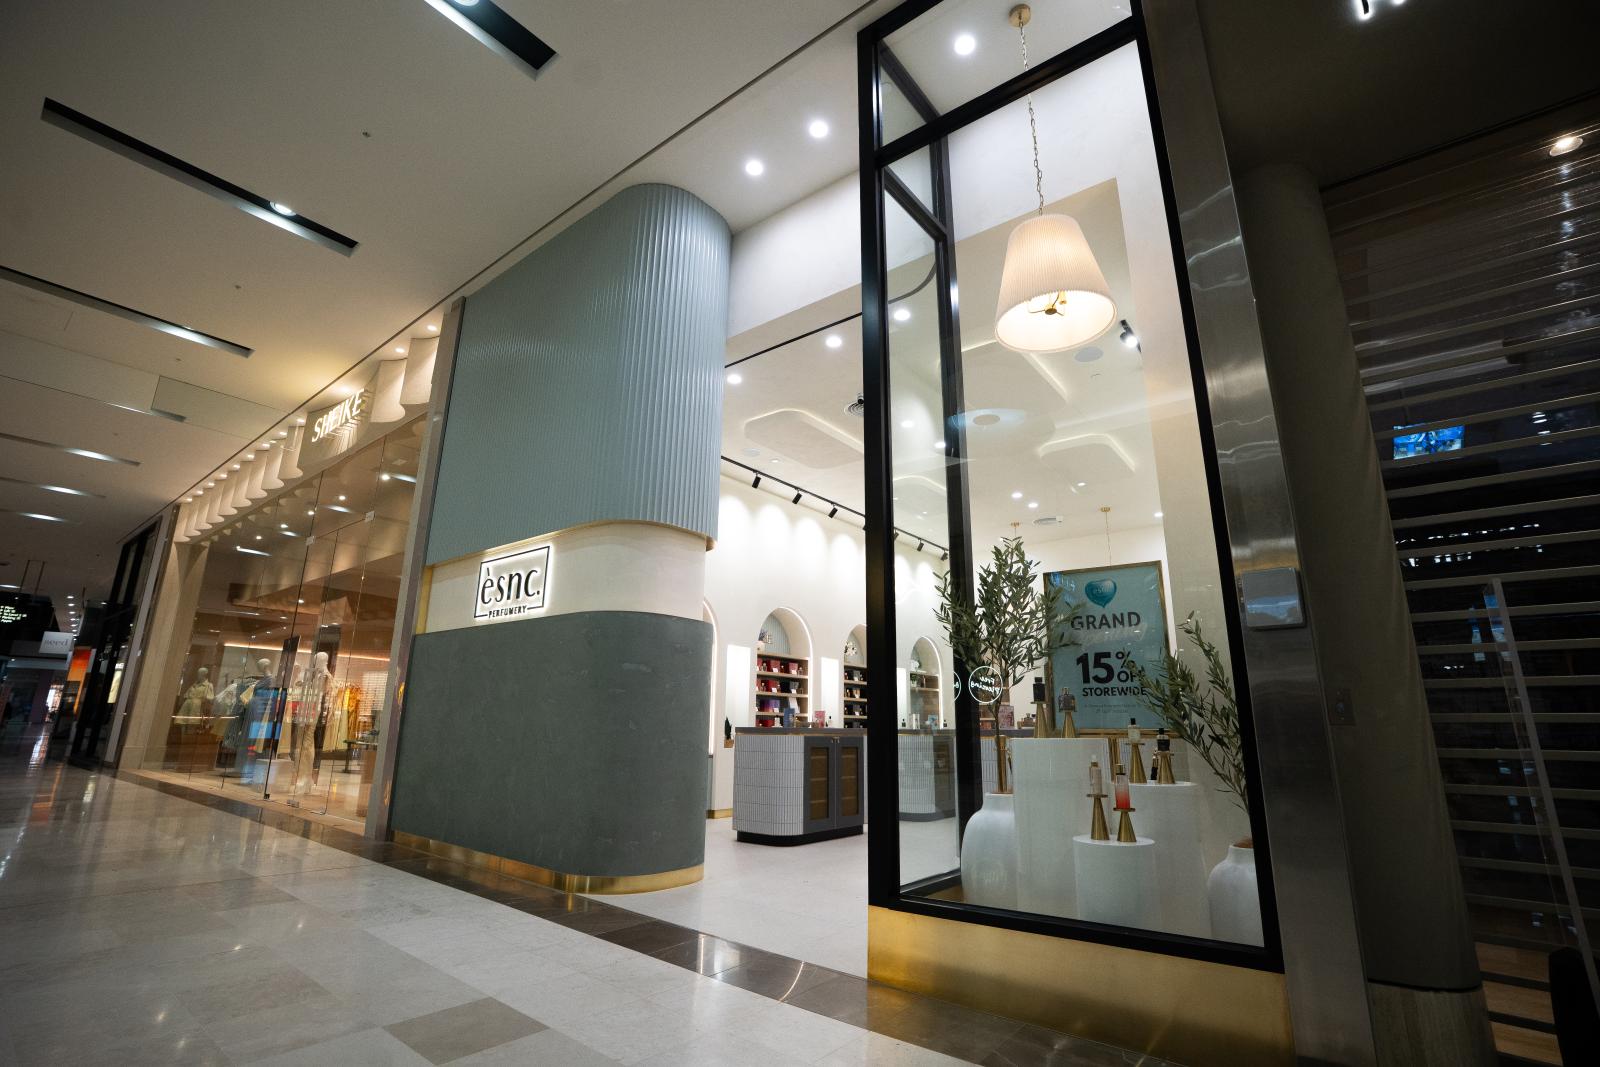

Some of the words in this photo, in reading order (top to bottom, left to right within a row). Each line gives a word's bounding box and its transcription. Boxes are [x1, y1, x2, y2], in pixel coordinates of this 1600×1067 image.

[311, 388, 365, 443] SHEIKE
[488, 605, 528, 619] PERFUMERY
[1070, 611, 1141, 630] GRAND
[1082, 686, 1148, 697] STOREWIDE
